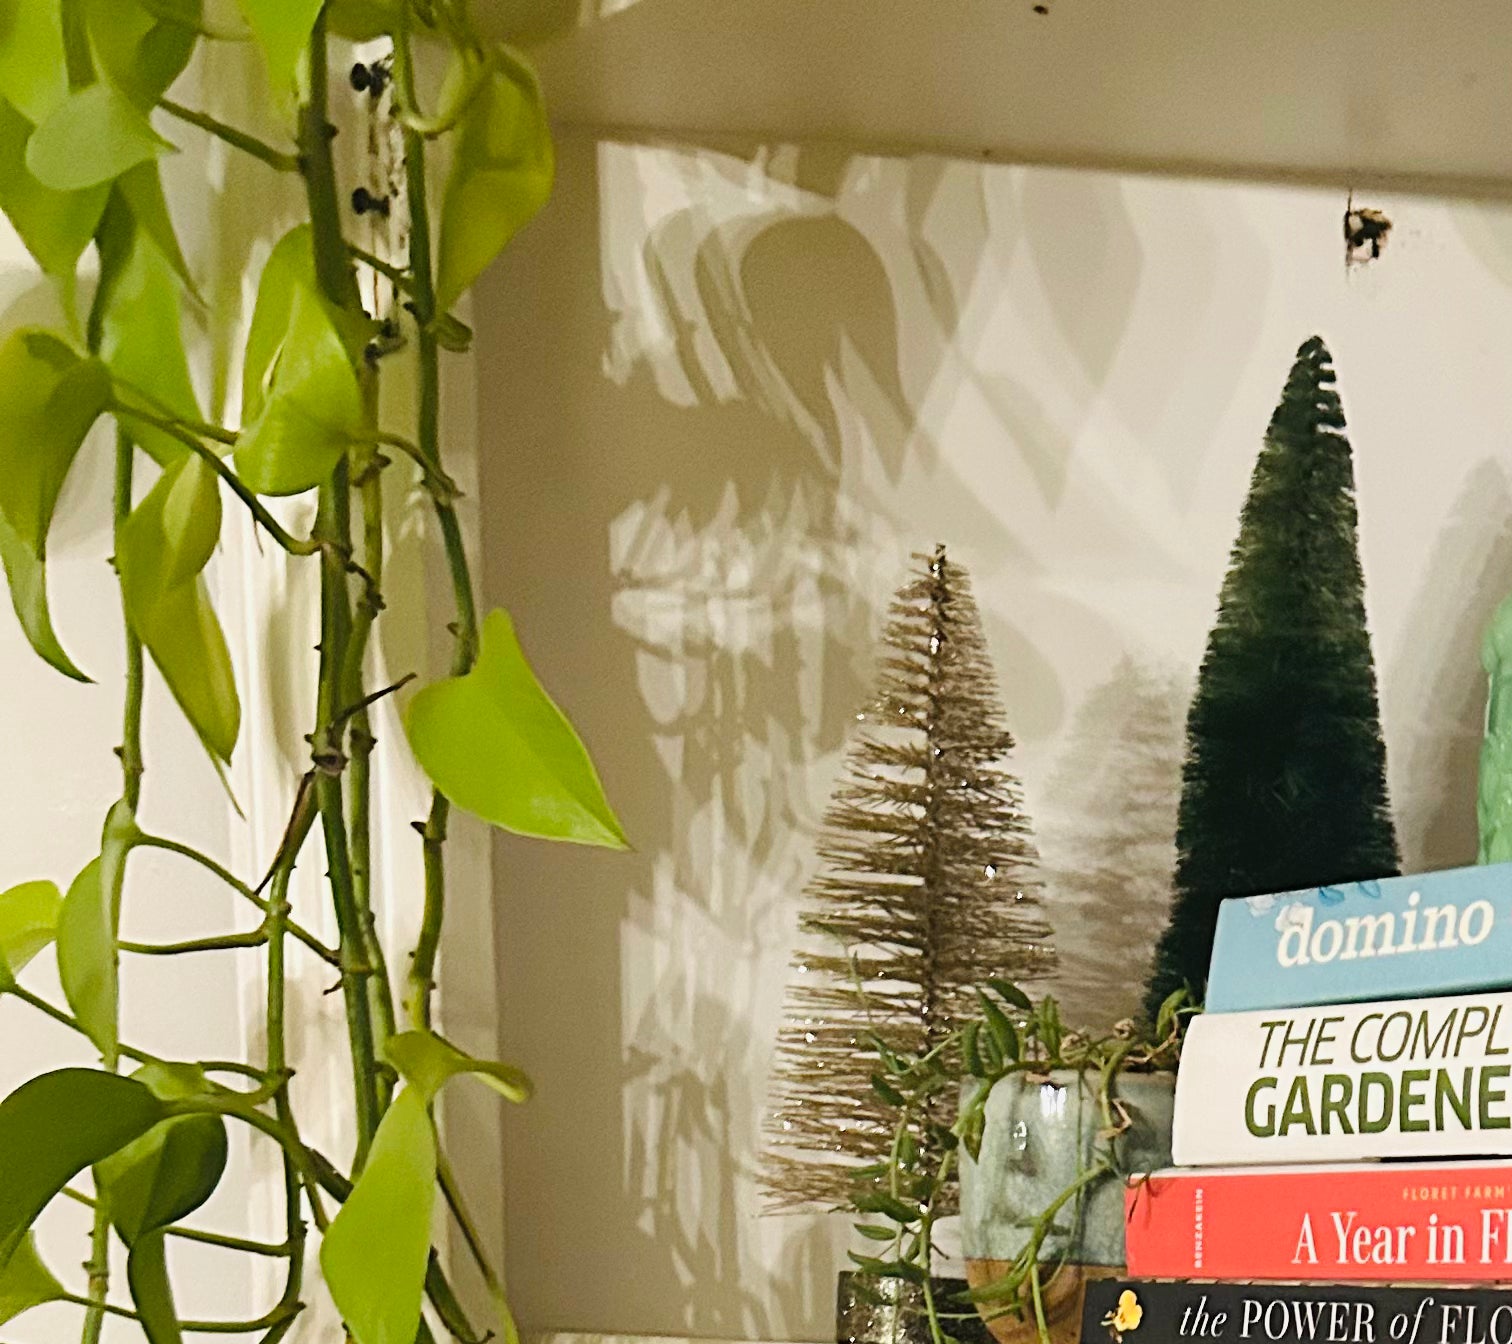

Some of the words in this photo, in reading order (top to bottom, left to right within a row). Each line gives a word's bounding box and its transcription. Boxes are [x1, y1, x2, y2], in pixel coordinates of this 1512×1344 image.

[1275, 891, 1495, 968] domino
[1258, 1016, 1345, 1069] THE
[1403, 1186, 1457, 1200] FLORET
[1291, 1211, 1319, 1264] A
[1330, 1210, 1416, 1265] Year
[1426, 1212, 1466, 1265] in
[1179, 1296, 1228, 1338] the
[1239, 1299, 1376, 1343] POWER
